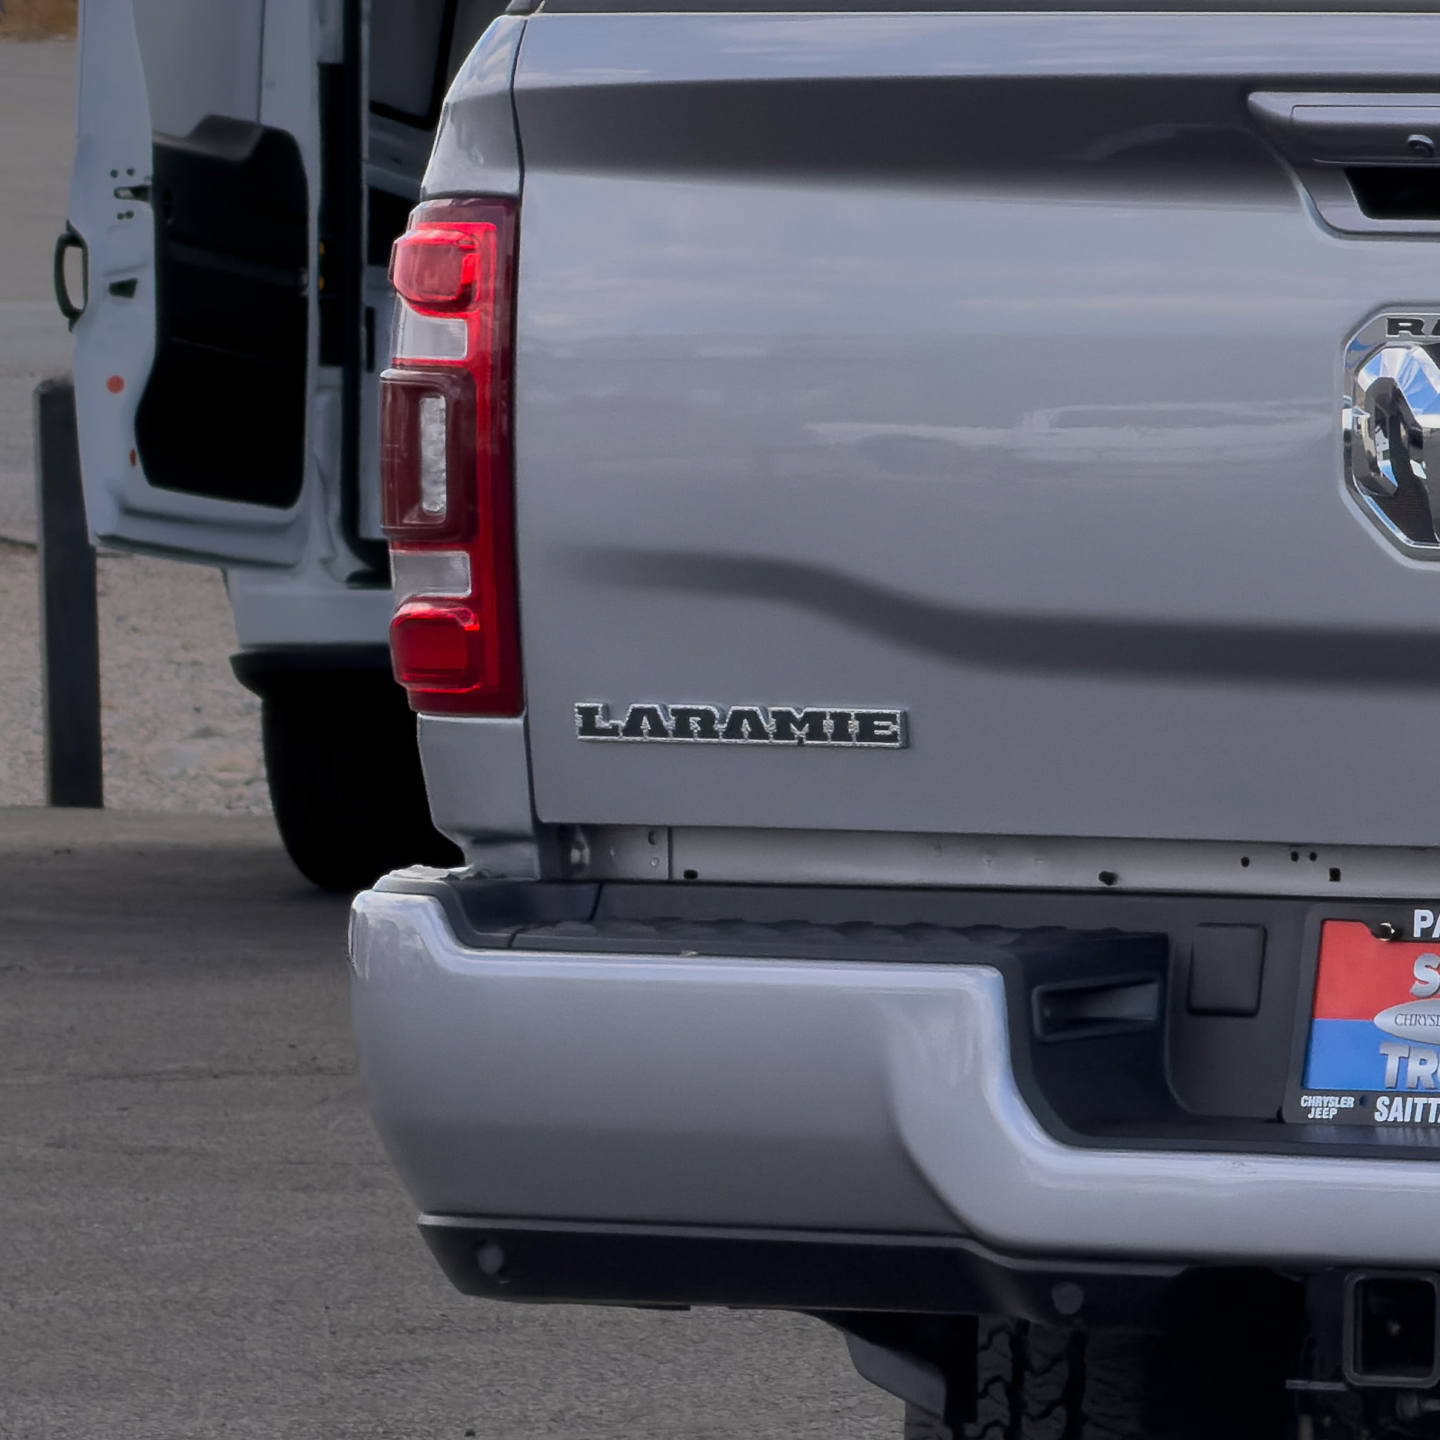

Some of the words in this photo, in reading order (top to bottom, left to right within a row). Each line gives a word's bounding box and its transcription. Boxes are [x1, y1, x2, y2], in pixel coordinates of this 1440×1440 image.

[574, 702, 905, 749] LARAMIE
[1300, 1094, 1356, 1109] CHRYSLER
[1307, 1107, 1339, 1120] JEEP
